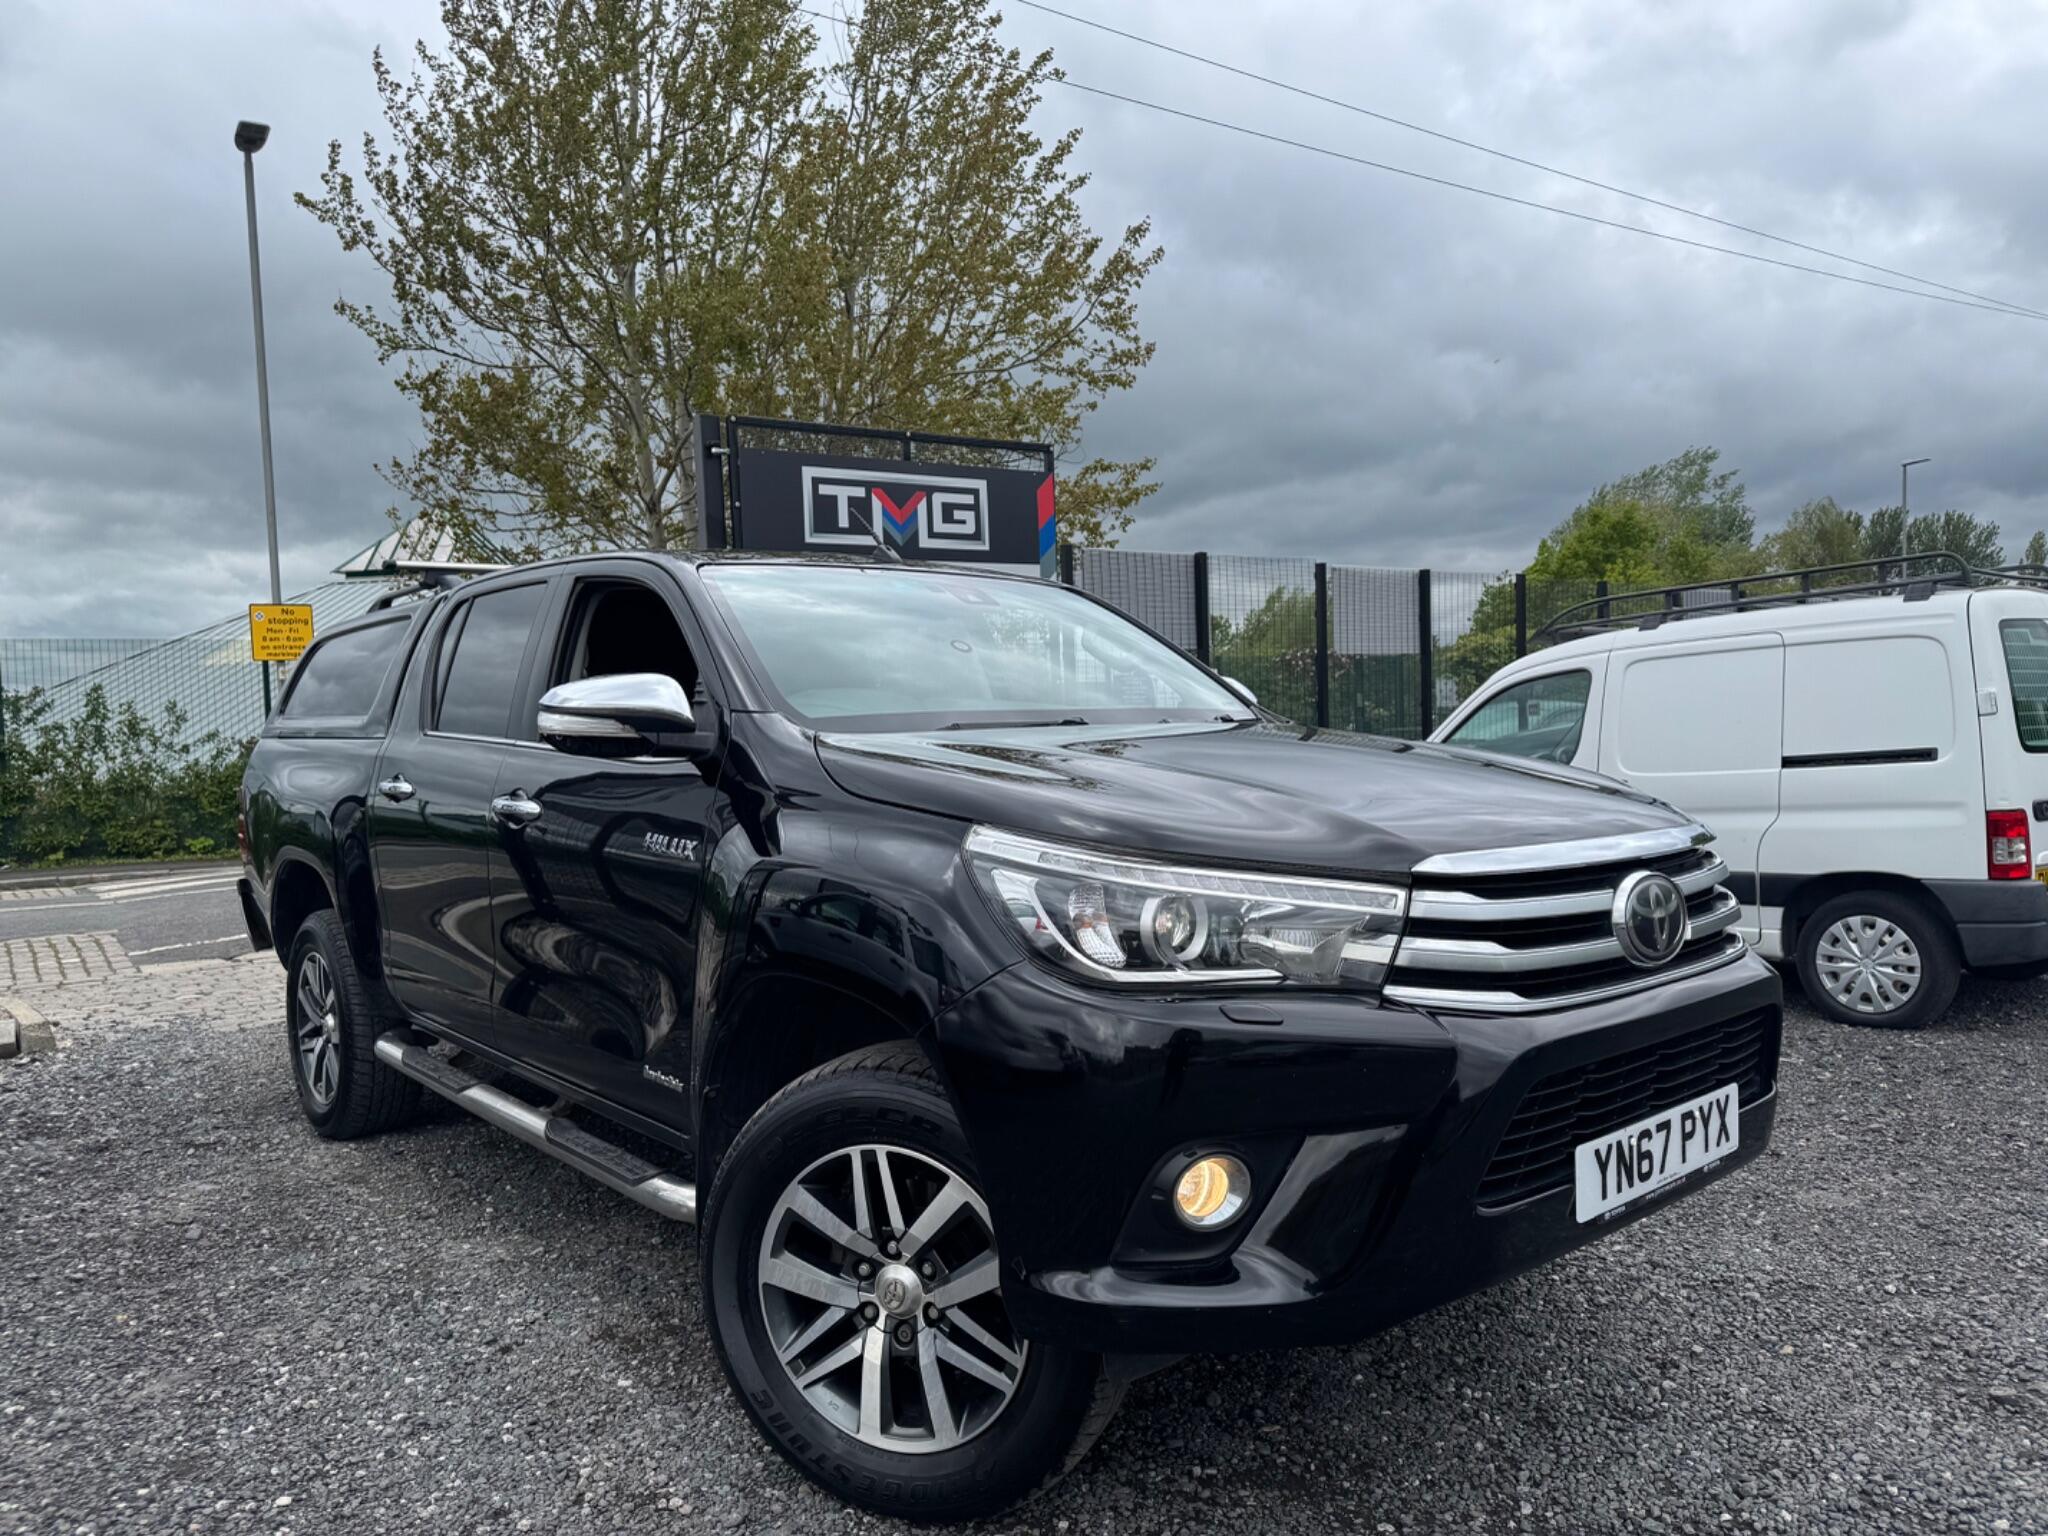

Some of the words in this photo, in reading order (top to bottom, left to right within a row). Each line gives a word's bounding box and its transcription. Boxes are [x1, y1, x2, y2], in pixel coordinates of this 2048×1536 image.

[818, 483, 976, 546] TMG
[267, 617, 309, 626] stopping
[281, 608, 295, 616] No
[642, 831, 699, 861] HILUX
[1593, 1118, 1672, 1201] YN67
[1680, 1093, 1731, 1165] PYX
